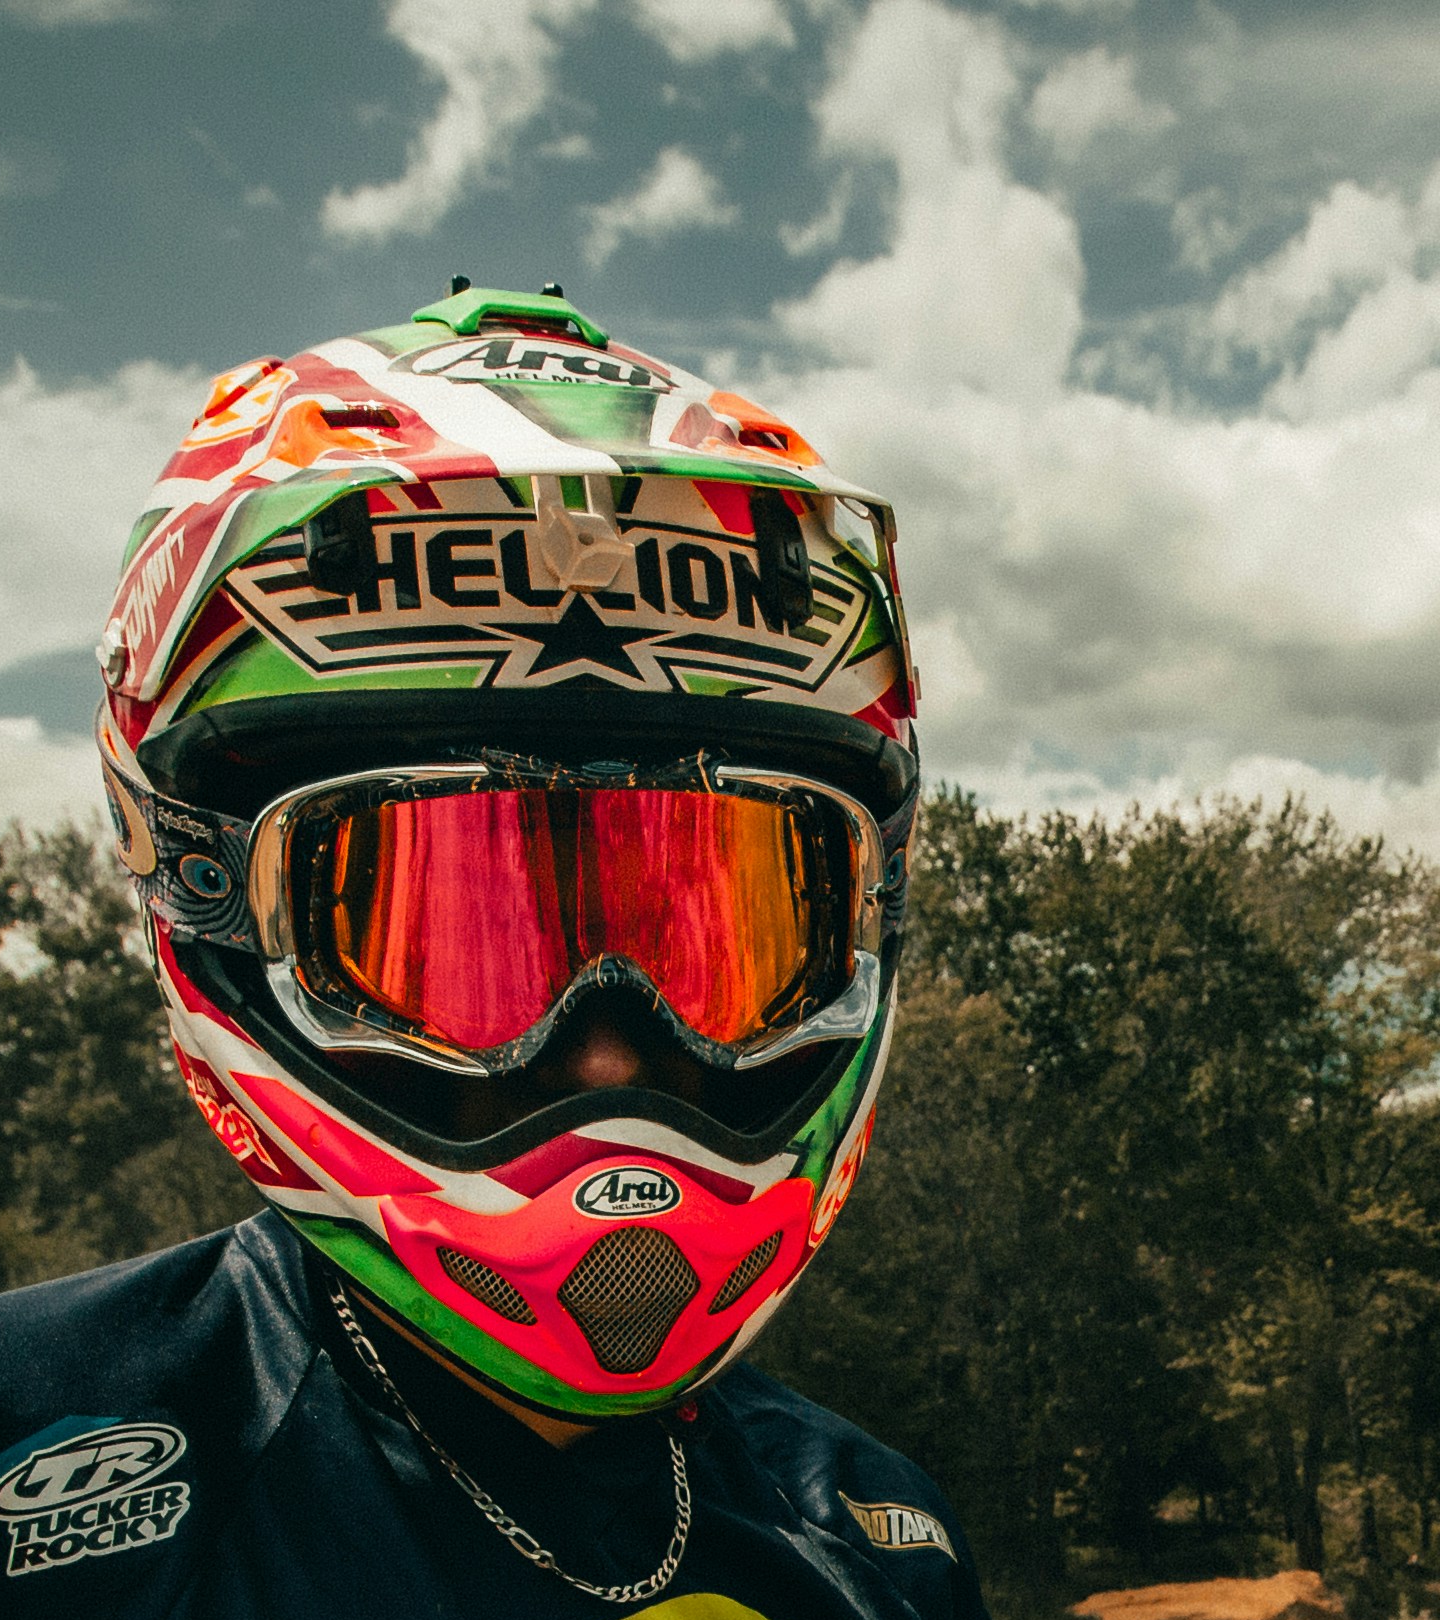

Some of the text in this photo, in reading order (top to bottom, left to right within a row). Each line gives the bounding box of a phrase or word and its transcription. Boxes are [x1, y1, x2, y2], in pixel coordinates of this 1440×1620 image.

[416, 340, 654, 386] Arai
[582, 1173, 671, 1210] Arai
[24, 1440, 153, 1499] TR
[10, 1506, 184, 1571] ROCKY
[12, 1485, 184, 1546] TUCKER
